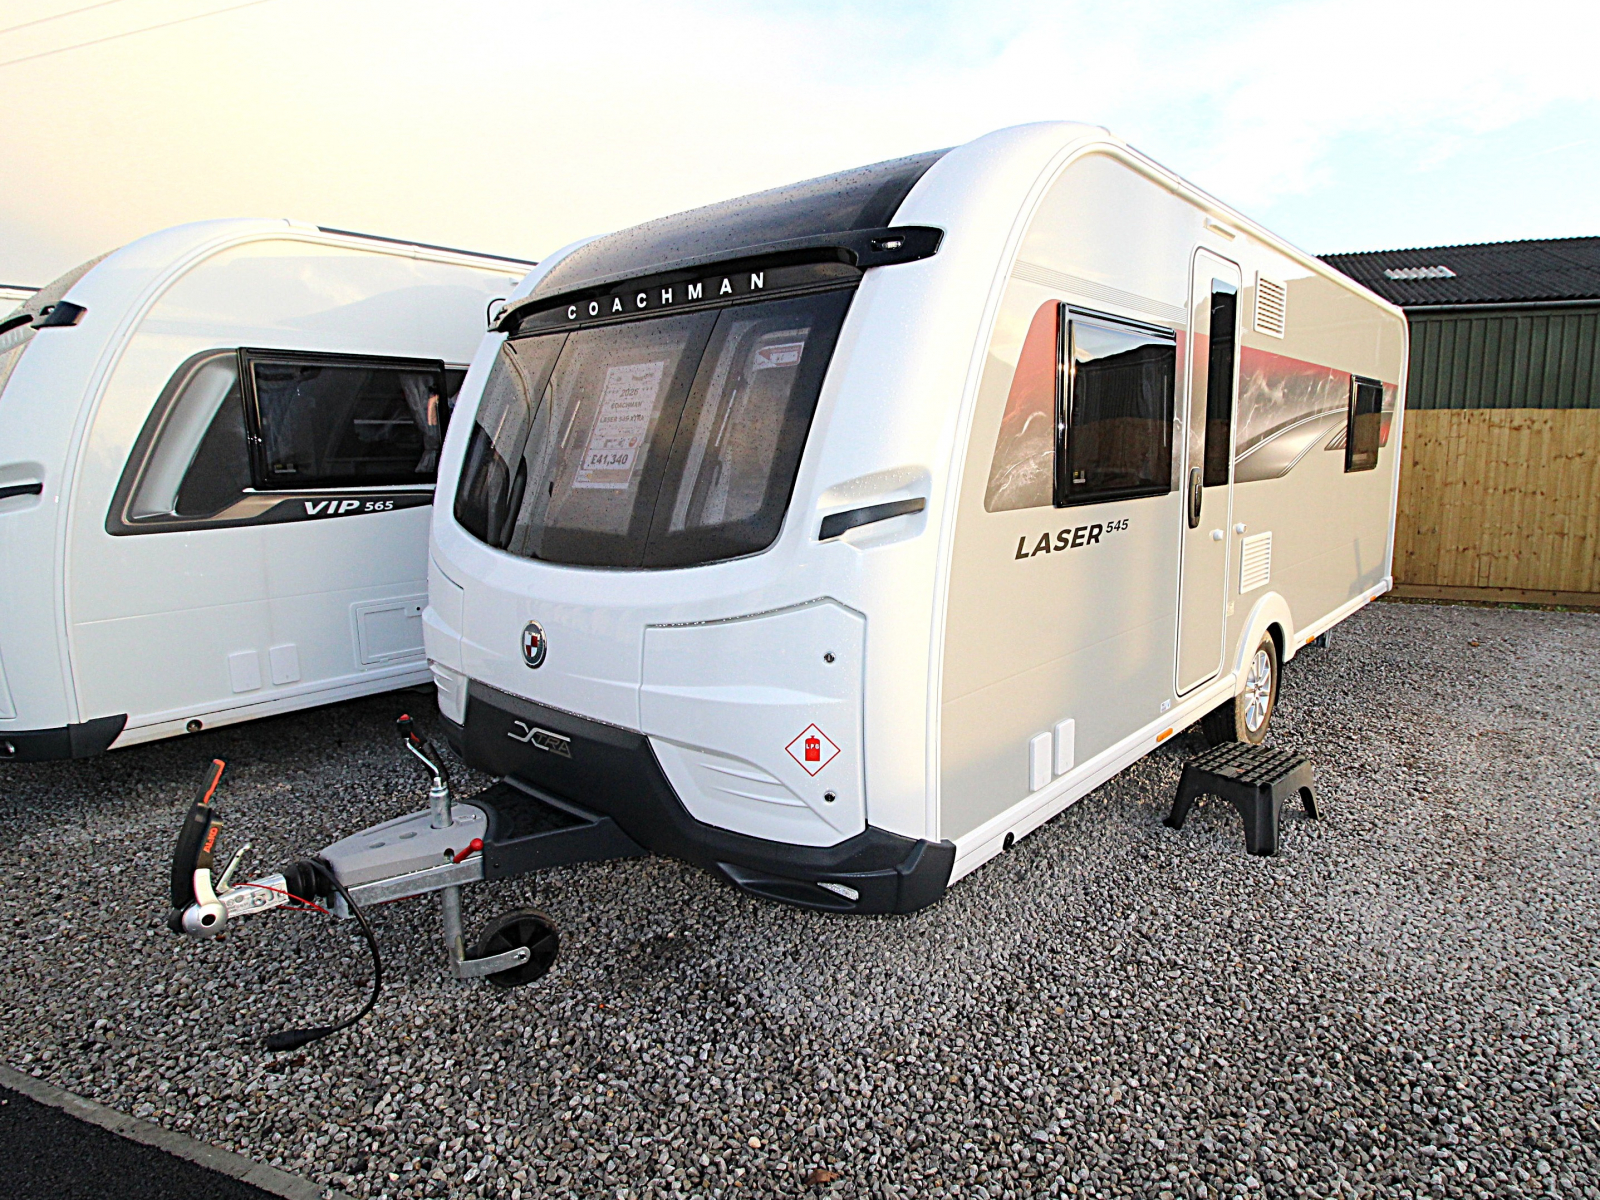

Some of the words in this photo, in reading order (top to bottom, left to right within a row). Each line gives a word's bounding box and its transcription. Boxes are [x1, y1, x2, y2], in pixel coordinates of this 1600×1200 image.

[567, 271, 764, 320] COACHMAN
[590, 454, 629, 467] £41,340
[304, 500, 360, 515] VIP
[364, 500, 394, 512] 565
[1014, 523, 1104, 560] LASER
[1105, 518, 1129, 534] 545
